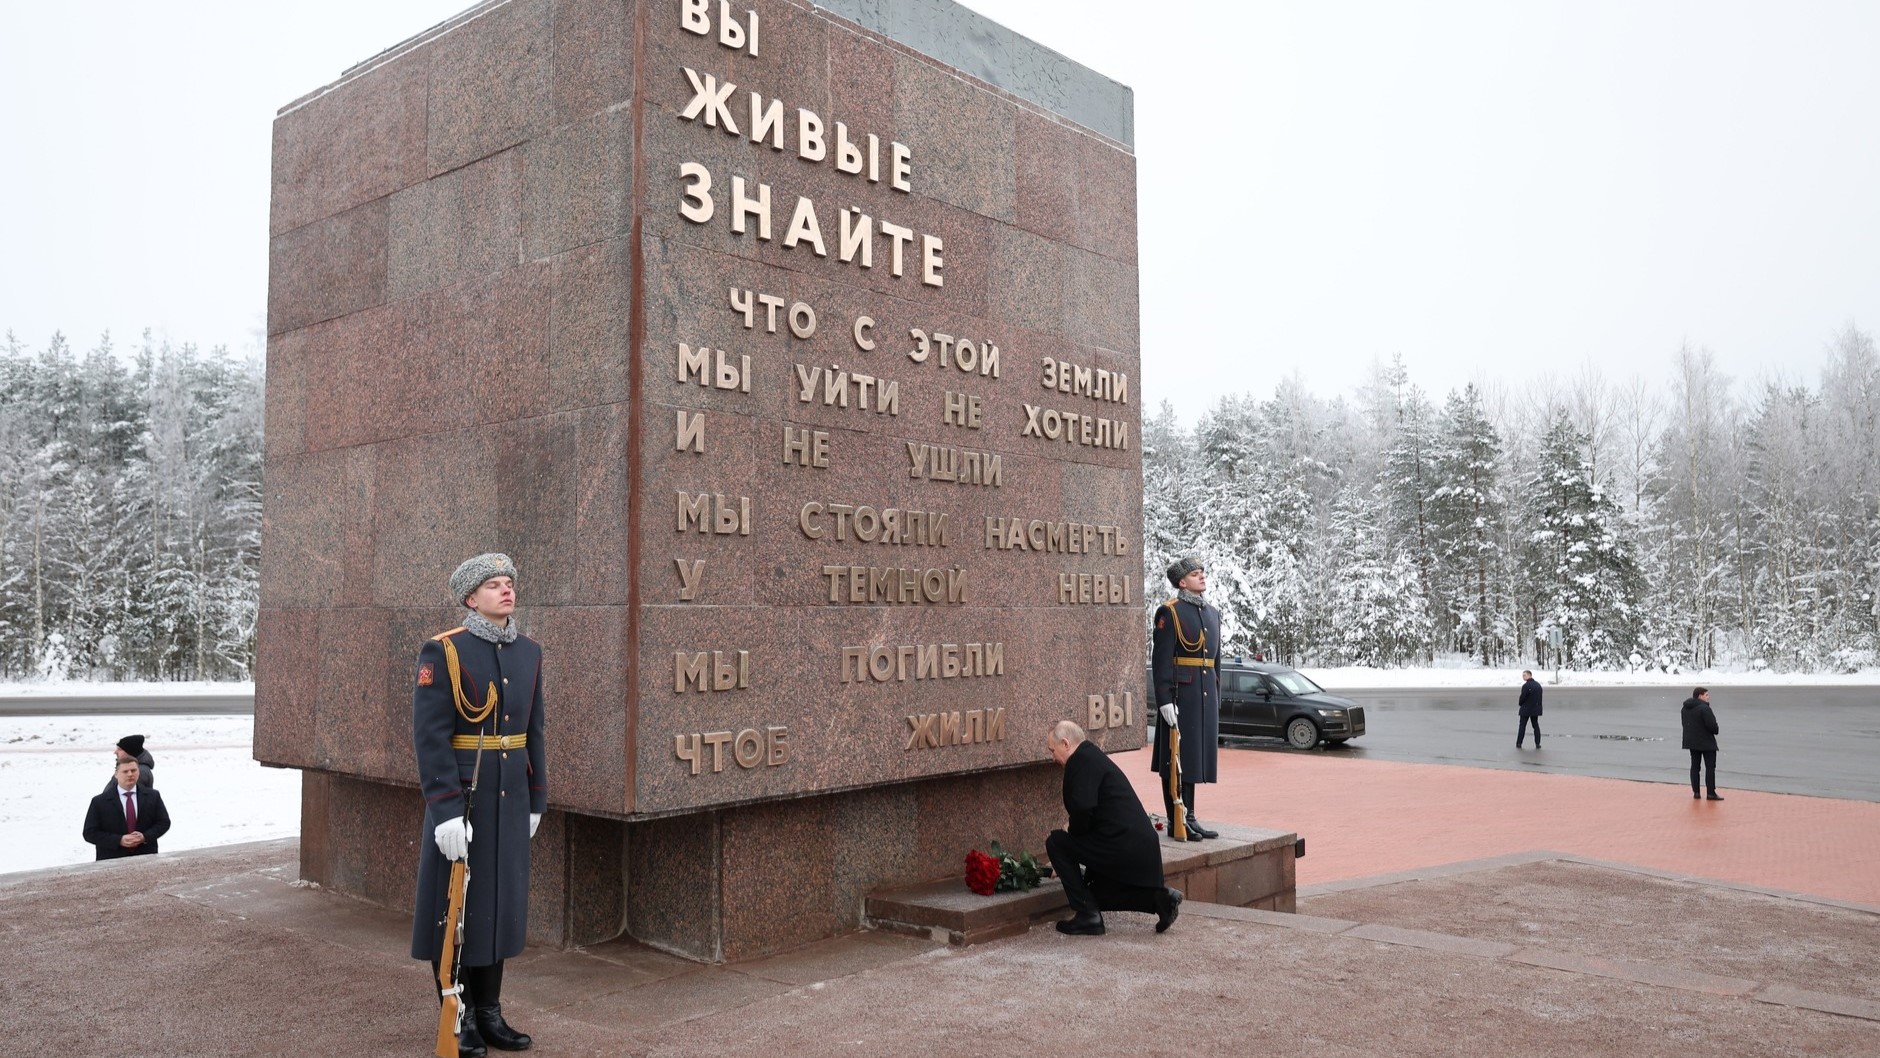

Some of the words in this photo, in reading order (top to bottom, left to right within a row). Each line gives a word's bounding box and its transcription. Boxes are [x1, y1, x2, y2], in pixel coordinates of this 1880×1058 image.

[680, 0, 759, 57] ВЫ
[677, 66, 912, 193] ЖИВЫЕ
[678, 162, 944, 288] ЗНАЙТЕ
[729, 288, 817, 339] ЧТО
[853, 315, 876, 352] С
[908, 328, 1000, 378] ЭТОЙ
[1041, 356, 1129, 404] ЗЕМЛИ
[677, 342, 751, 394] МЫ
[795, 363, 900, 417] УЙТИ
[943, 391, 983, 429] НЕ
[1021, 403, 1129, 451] ХОТЕЛИ
[675, 410, 705, 454] И
[782, 426, 830, 469] НЕ
[905, 441, 1002, 488] УШЛИ
[676, 490, 751, 536] МЫ
[799, 501, 950, 547] СТОЯЛИ
[984, 516, 1129, 557] НАСМЕРТЬ
[674, 557, 707, 602] У
[822, 563, 968, 603] ТЕМНОЙ
[1058, 572, 1130, 606] НЕВЫ
[673, 650, 750, 694] МЫ
[840, 642, 1005, 684] ПОГИБЛИ
[674, 725, 792, 776] ЧТОБ
[903, 707, 1006, 752] ЖИЛИ
[1087, 691, 1134, 732] ВЫ
